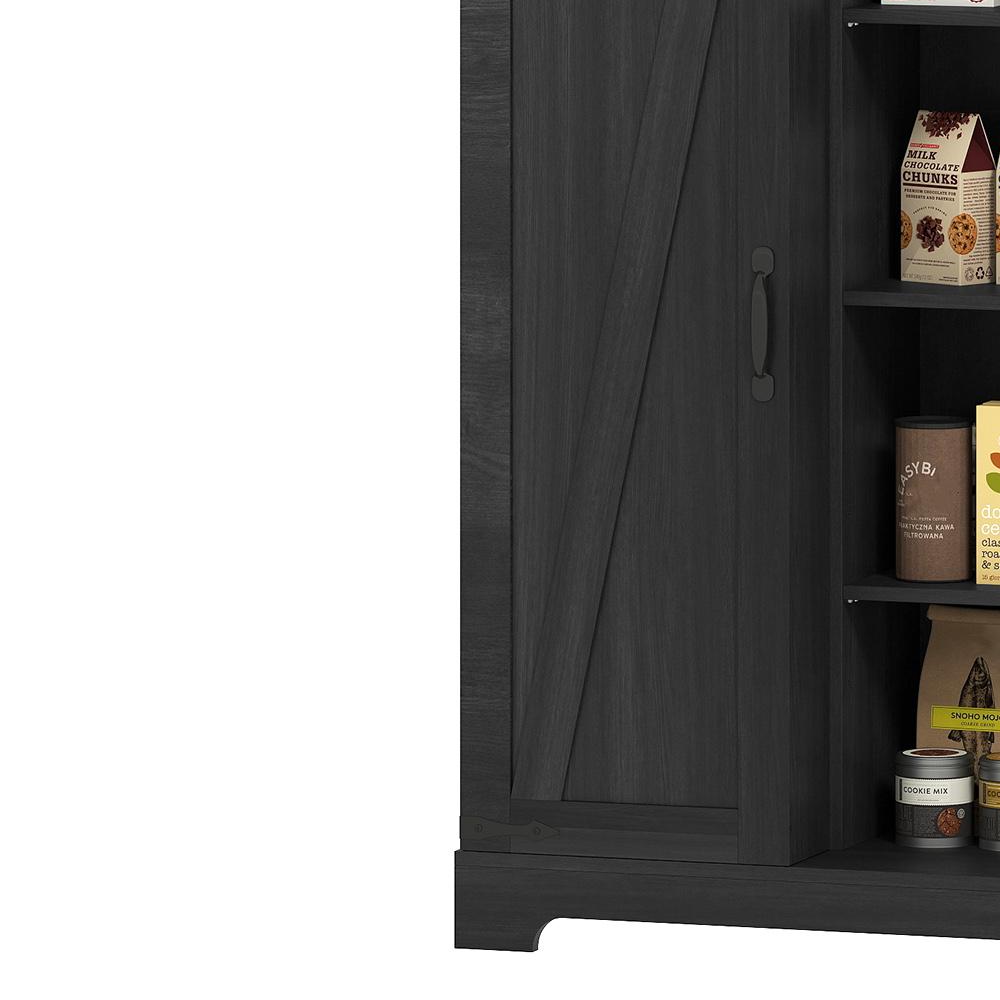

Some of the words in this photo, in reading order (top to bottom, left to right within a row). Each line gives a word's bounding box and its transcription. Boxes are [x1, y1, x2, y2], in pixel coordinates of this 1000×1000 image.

[907, 150, 937, 160] MILK
[904, 160, 960, 172] CHOCOLATE
[903, 171, 958, 185] CHUNKS
[982, 560, 991, 569] &
[951, 712, 980, 720] SNOHO
